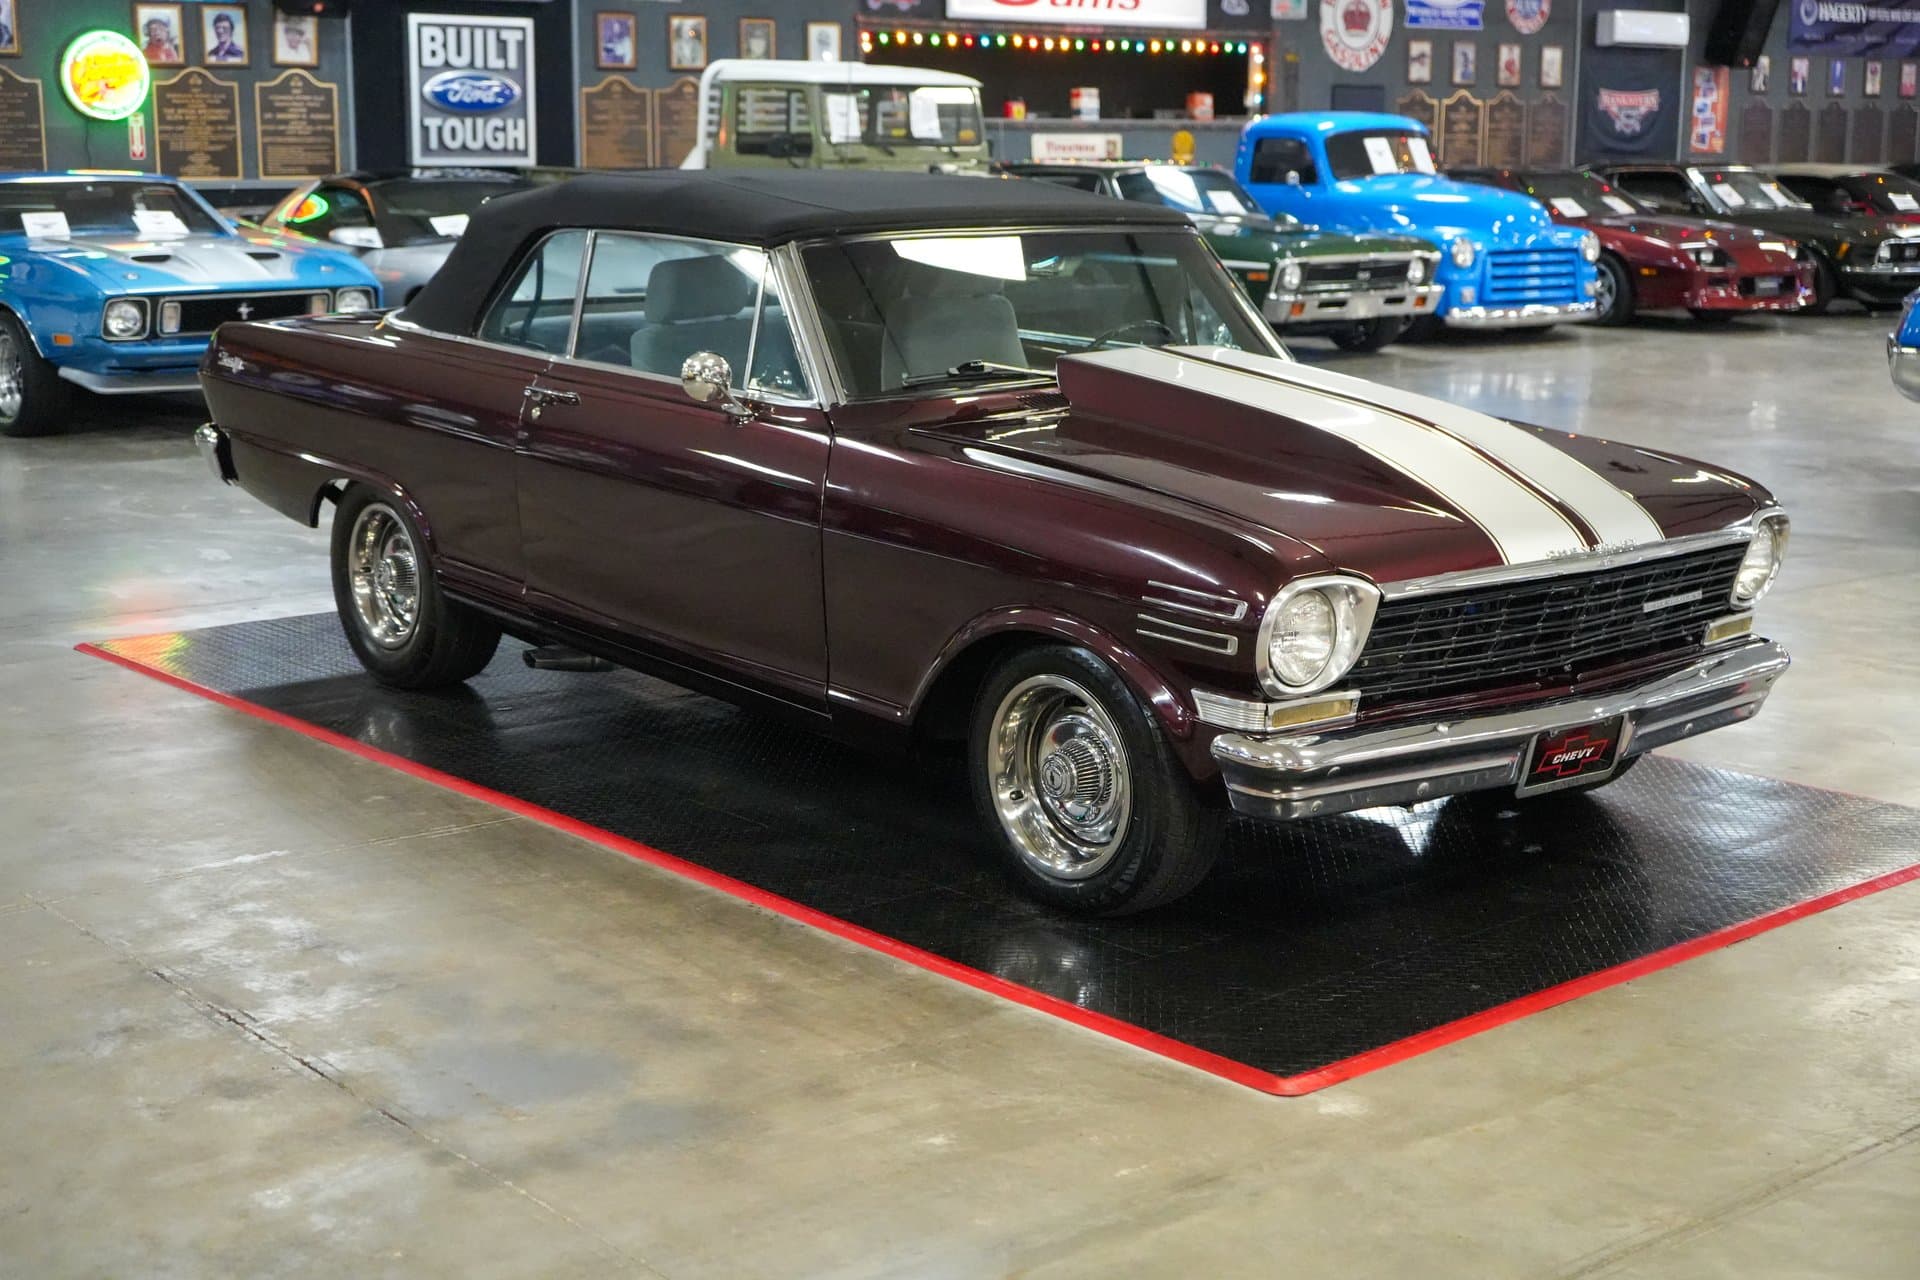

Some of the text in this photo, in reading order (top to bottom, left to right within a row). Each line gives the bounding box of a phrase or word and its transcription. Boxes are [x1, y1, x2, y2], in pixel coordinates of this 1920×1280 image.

[420, 26, 524, 69] BUILT
[431, 79, 505, 103] Ford
[423, 117, 526, 151] TOUGH
[1551, 746, 1595, 765] CHEVY
